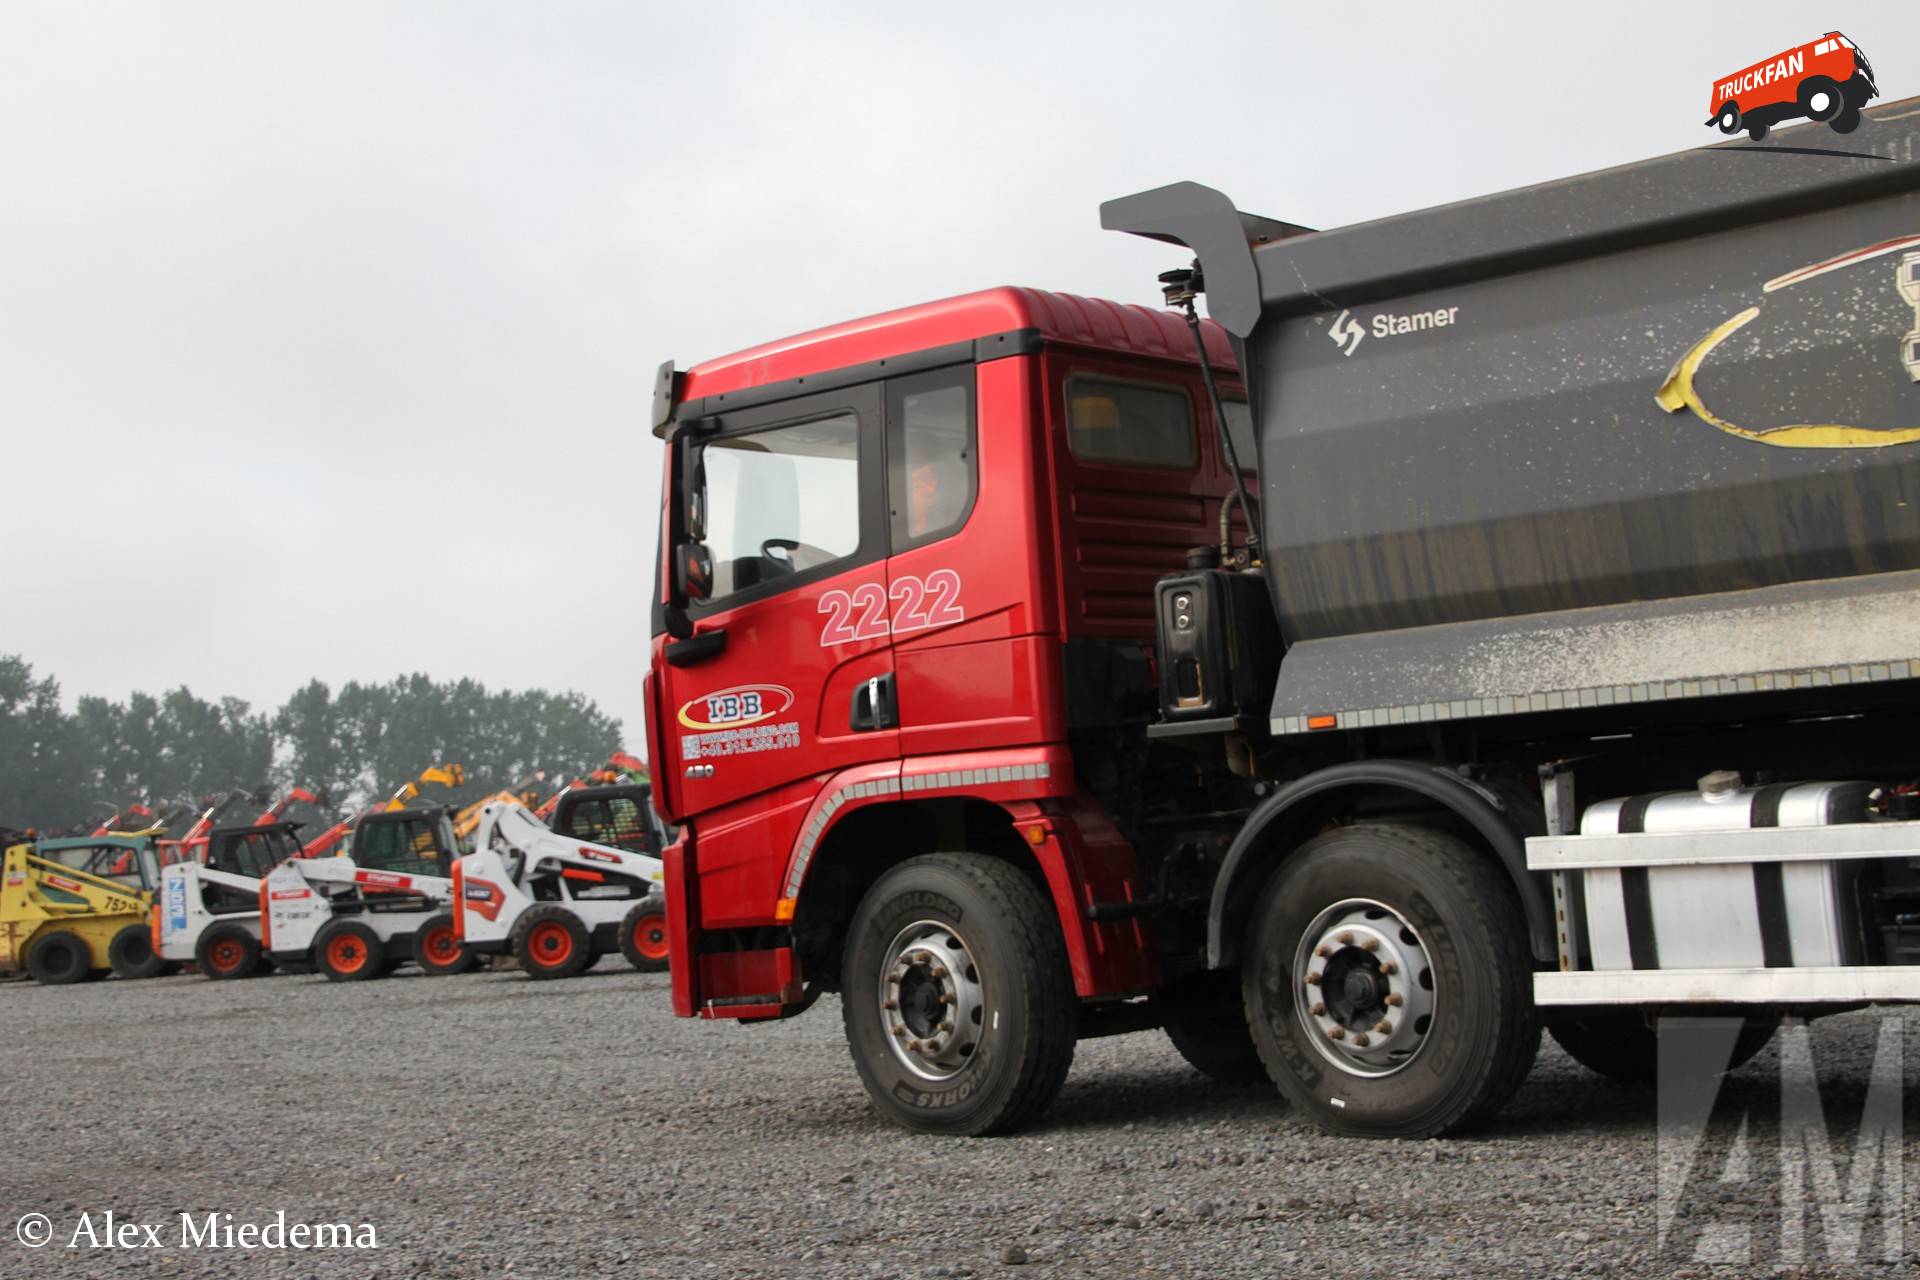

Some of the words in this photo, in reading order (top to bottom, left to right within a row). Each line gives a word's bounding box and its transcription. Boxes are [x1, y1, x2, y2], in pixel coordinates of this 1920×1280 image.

[1372, 306, 1459, 338] Stamer
[817, 568, 964, 647] 2222
[709, 693, 761, 721] IBB
